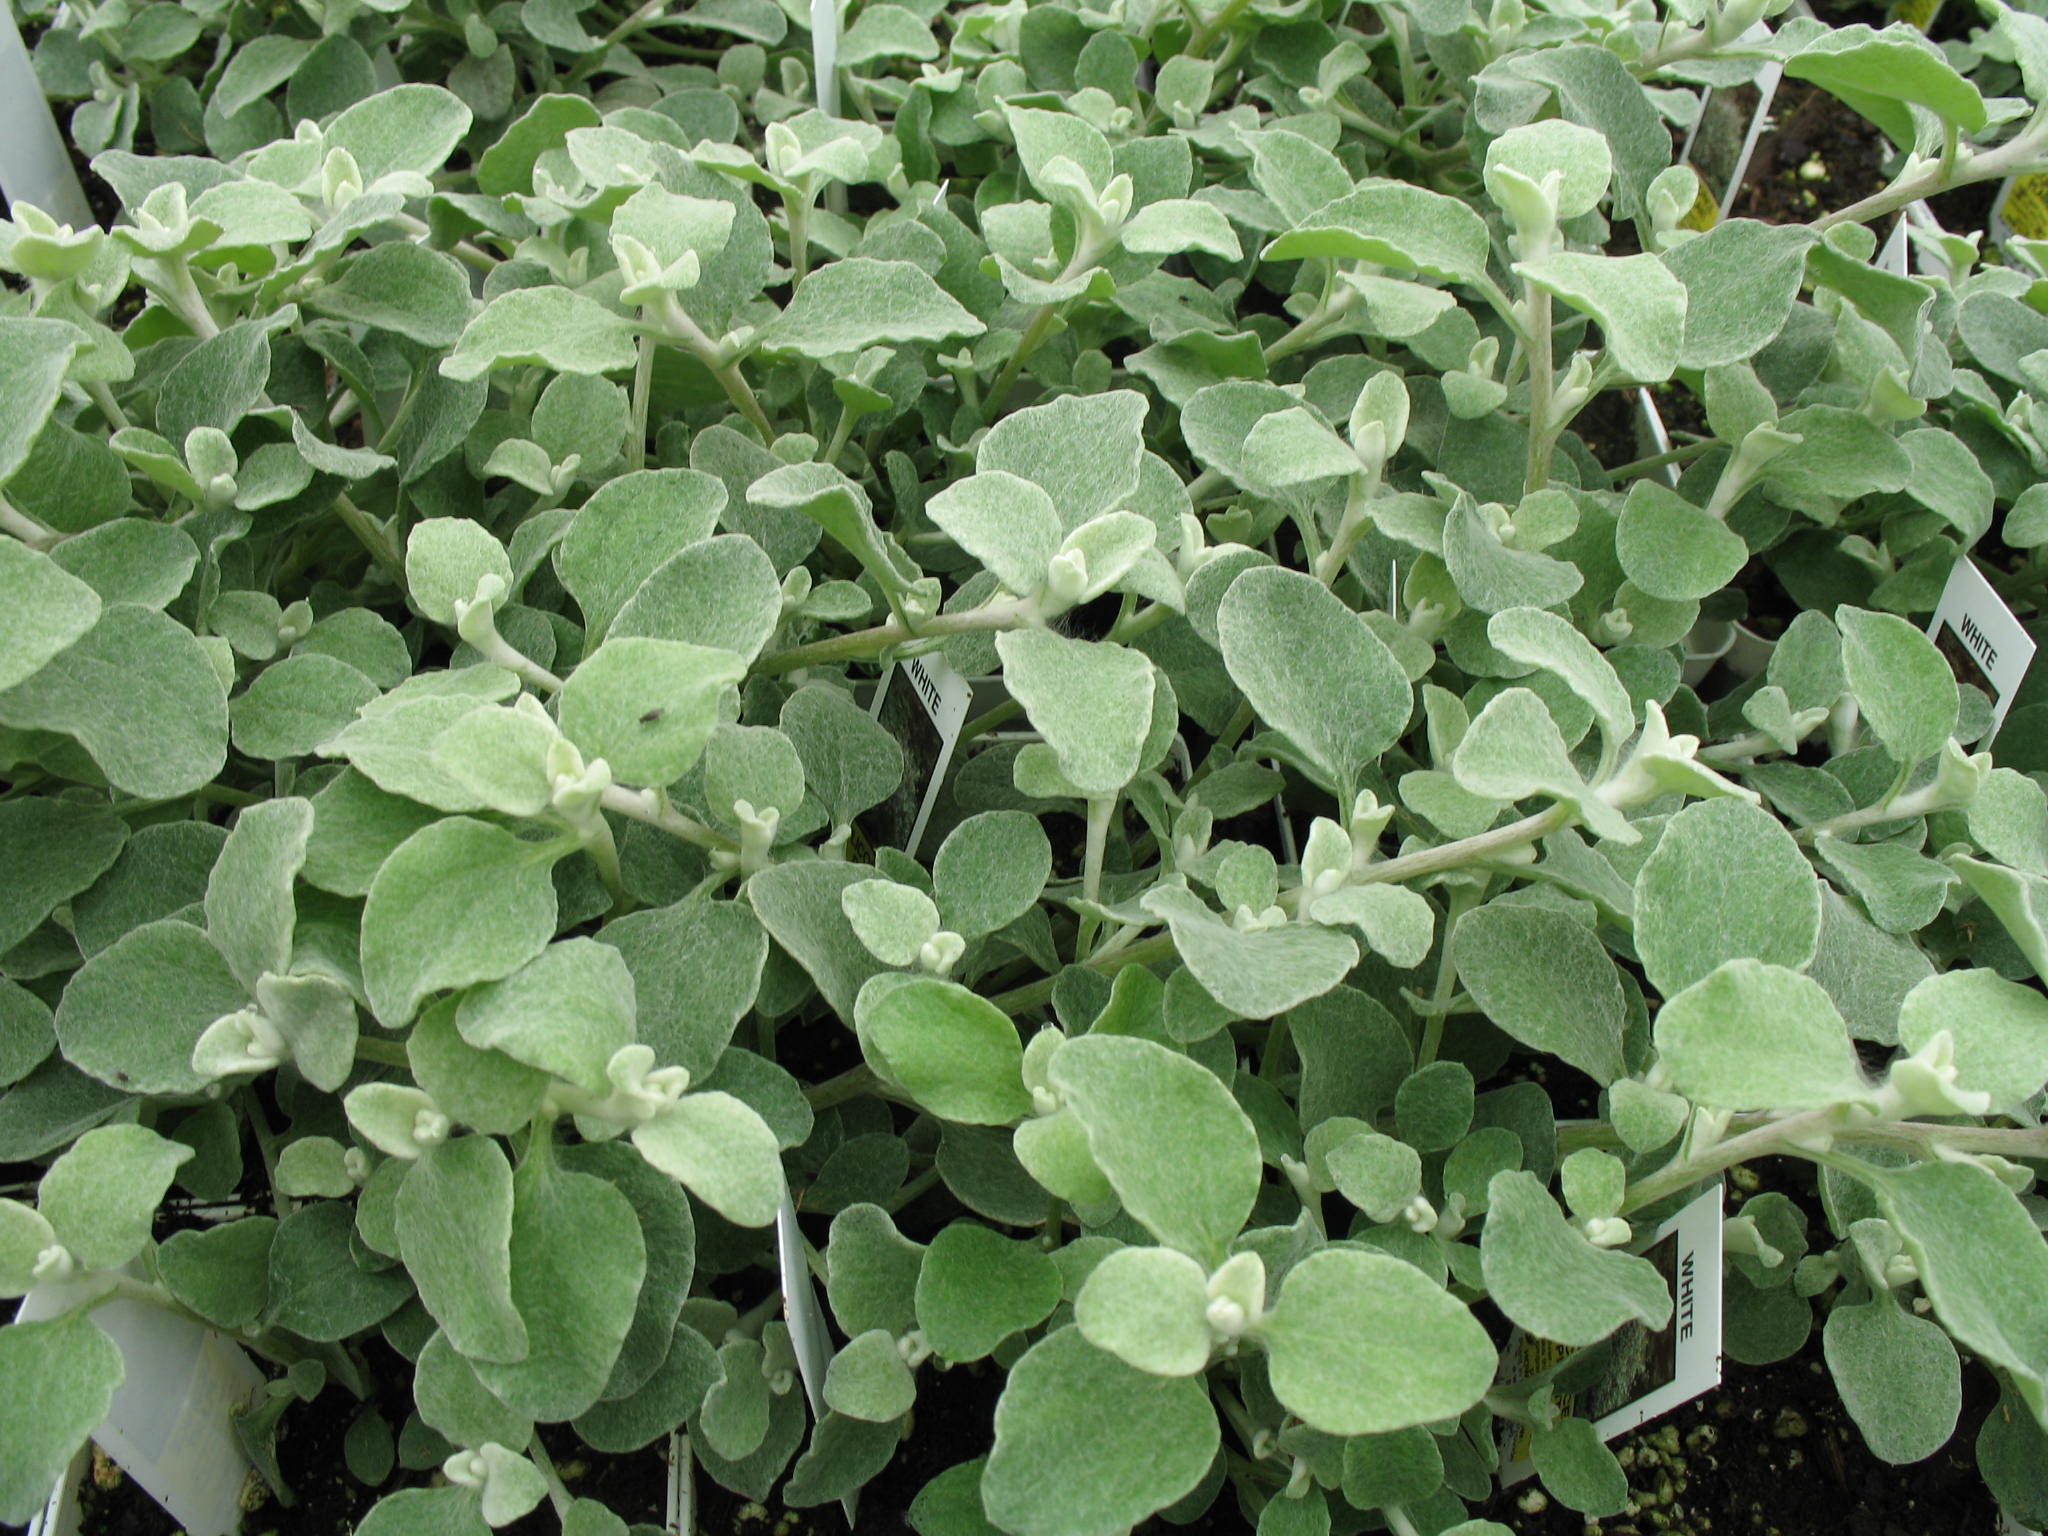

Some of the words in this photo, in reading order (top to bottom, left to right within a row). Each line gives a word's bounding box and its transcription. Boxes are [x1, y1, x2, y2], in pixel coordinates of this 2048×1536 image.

[1960, 612, 1998, 671] WHITE
[911, 657, 942, 716] WHITE
[1681, 1250, 1694, 1343] WHITE
